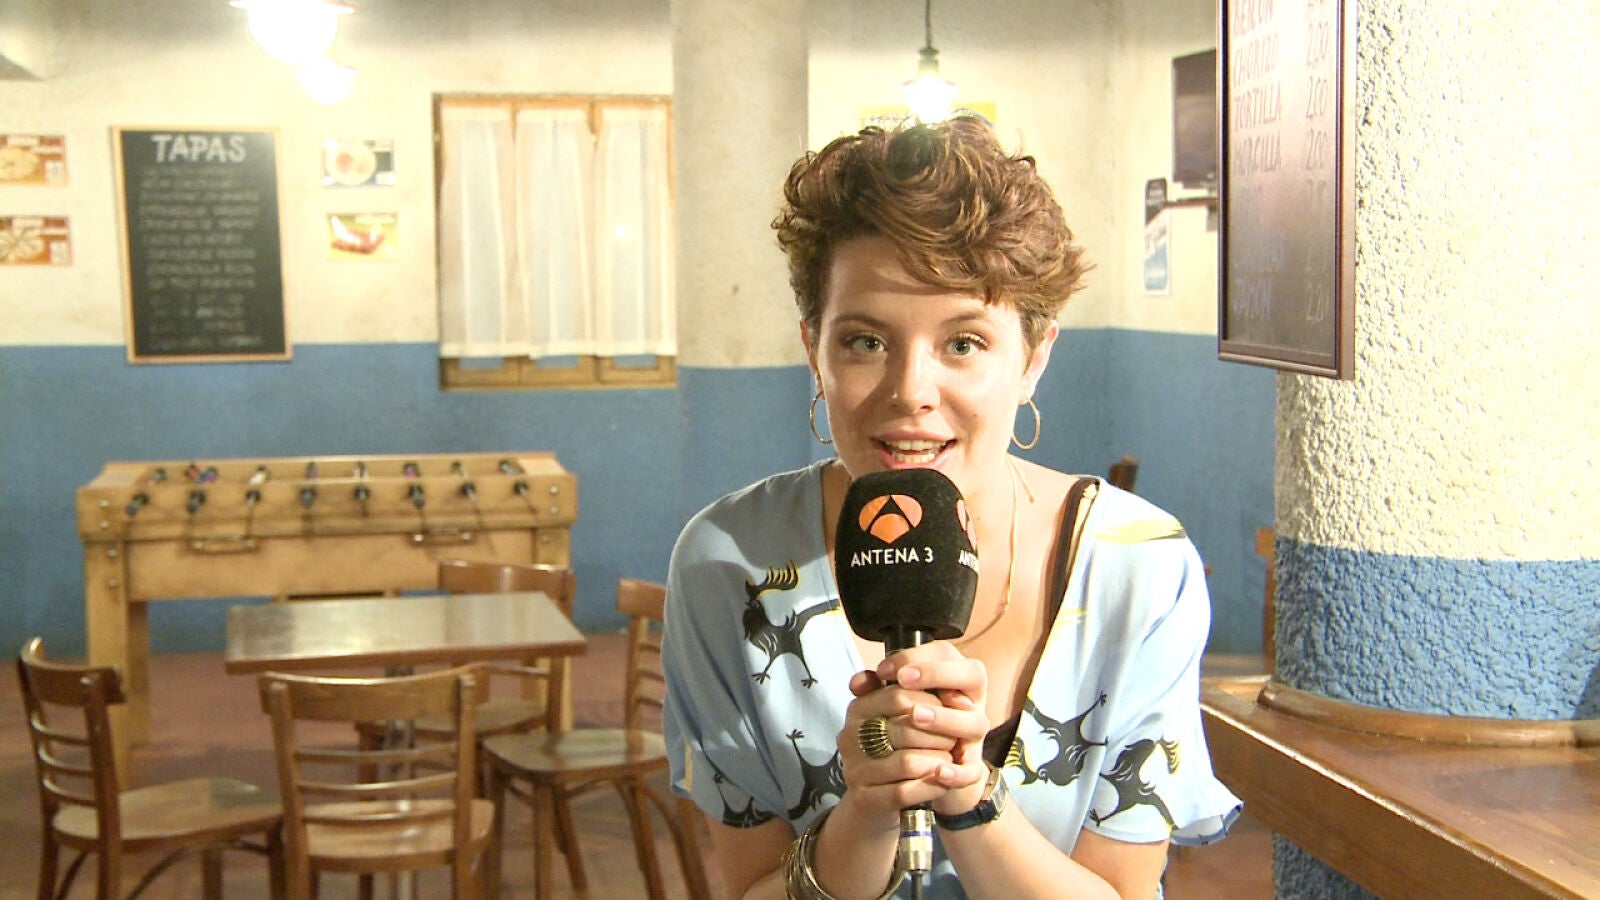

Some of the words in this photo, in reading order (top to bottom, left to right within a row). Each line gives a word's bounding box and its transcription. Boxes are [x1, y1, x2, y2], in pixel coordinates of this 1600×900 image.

[1233, 32, 1280, 88] CHORIZO
[1233, 80, 1282, 133] TORTILLA
[151, 133, 247, 163] TAPAS
[851, 547, 920, 567] ANTENA
[924, 547, 934, 563] 3
